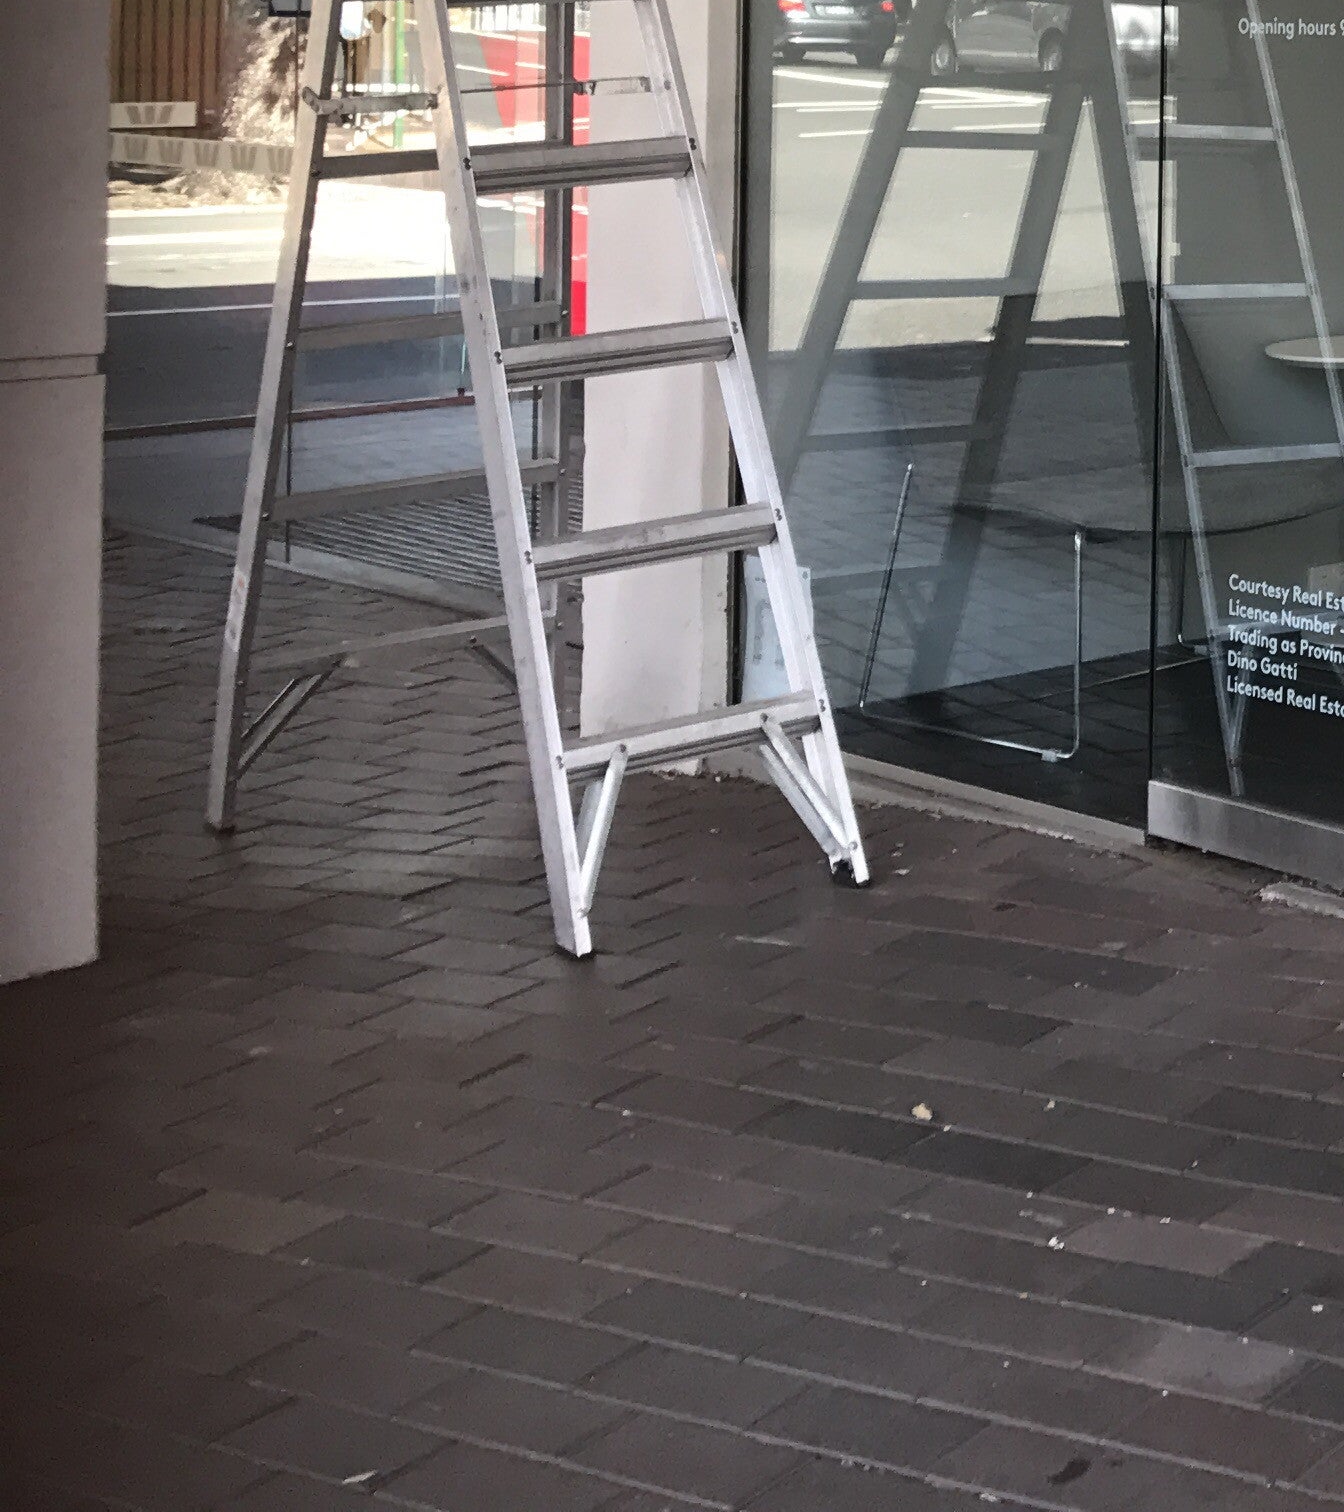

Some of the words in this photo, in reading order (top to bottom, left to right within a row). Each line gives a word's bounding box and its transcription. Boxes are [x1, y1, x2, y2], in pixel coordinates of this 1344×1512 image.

[1238, 17, 1295, 40] Opening
[1298, 18, 1337, 36] hours
[1228, 573, 1290, 605] Courtesy
[1292, 585, 1322, 607] Real
[1228, 598, 1278, 624] Licence
[1281, 609, 1337, 635] Number
[1228, 624, 1278, 655] Trading
[1281, 639, 1297, 654] as
[1227, 650, 1257, 672] Dino
[1260, 657, 1298, 680] Gatti
[1227, 675, 1283, 703] Licensed
[1287, 688, 1316, 711] Real
